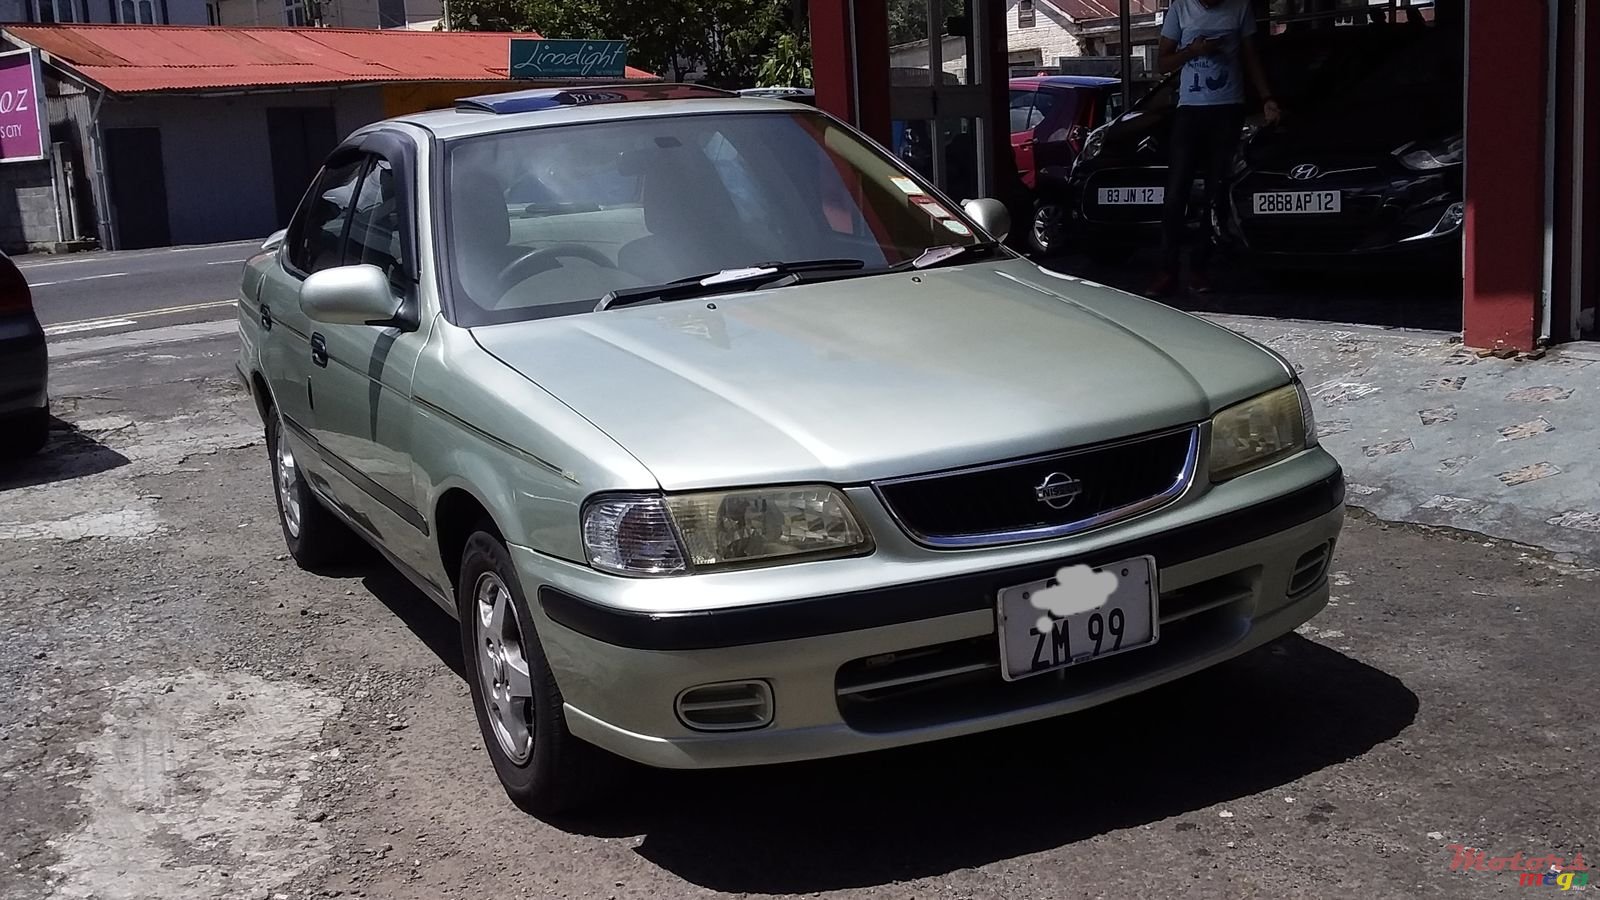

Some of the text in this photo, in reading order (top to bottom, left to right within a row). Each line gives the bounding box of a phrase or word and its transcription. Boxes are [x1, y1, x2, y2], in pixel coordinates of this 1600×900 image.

[514, 42, 624, 76] Limelight
[6, 124, 22, 138] CITY
[1107, 188, 1154, 203] 83 JN 12
[1259, 192, 1334, 212] 2868 AP 12
[1088, 608, 1124, 656] 99
